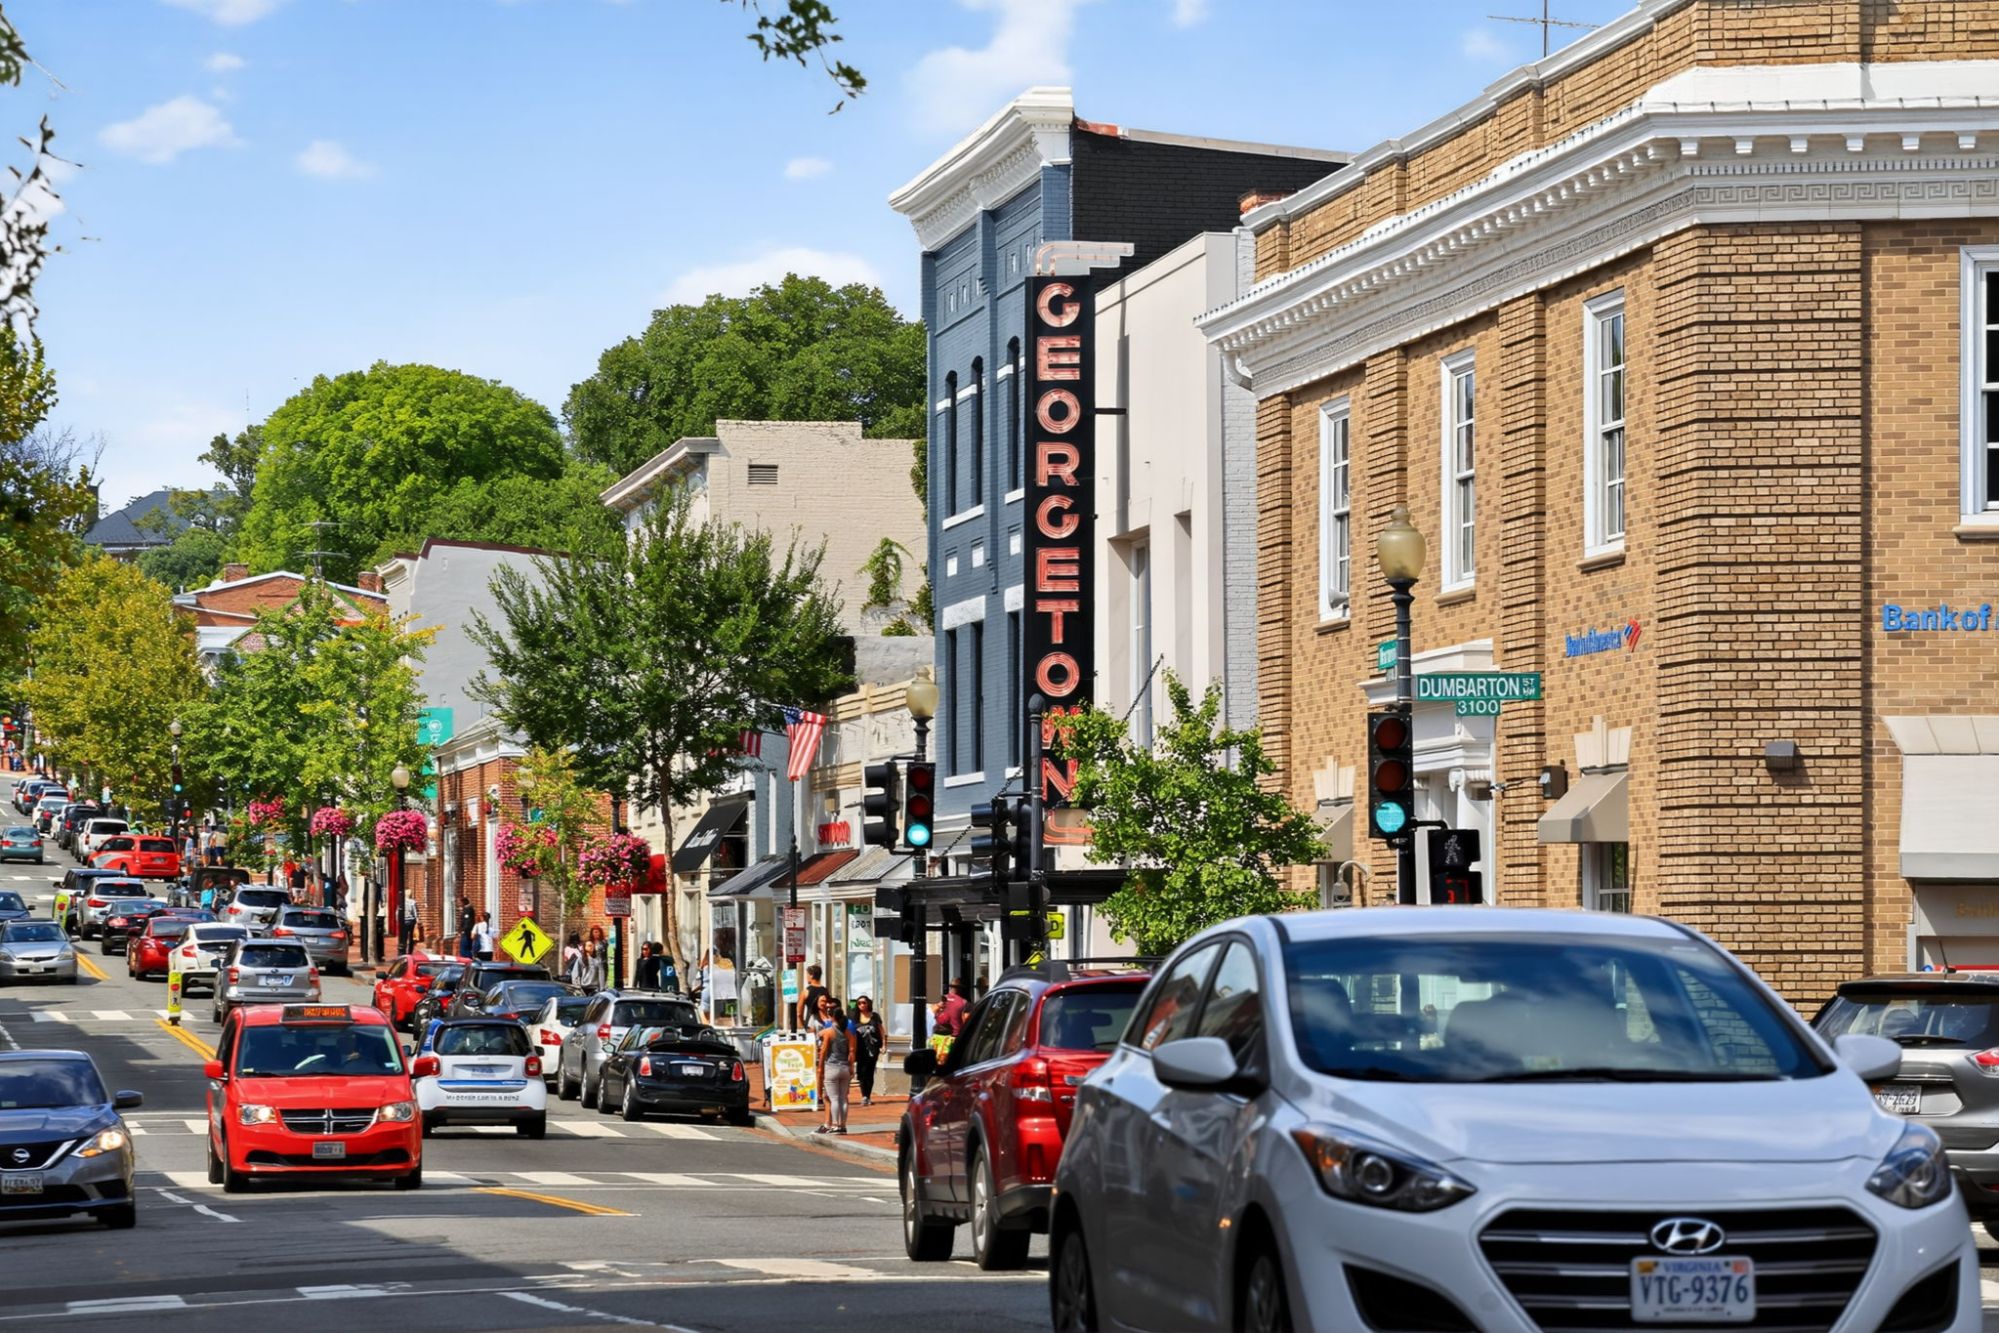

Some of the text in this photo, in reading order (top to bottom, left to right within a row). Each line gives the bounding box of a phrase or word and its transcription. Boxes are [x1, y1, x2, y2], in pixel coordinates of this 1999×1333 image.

[1035, 282, 1081, 807] GEORGETOWN
[1883, 604, 1991, 631] Bank of
[1419, 678, 1536, 698] DUMBARTON ST
[1458, 700, 1499, 714] 3100
[1663, 1261, 1721, 1273] VIRGINIA
[1639, 1274, 1749, 1305] VTG-9376
